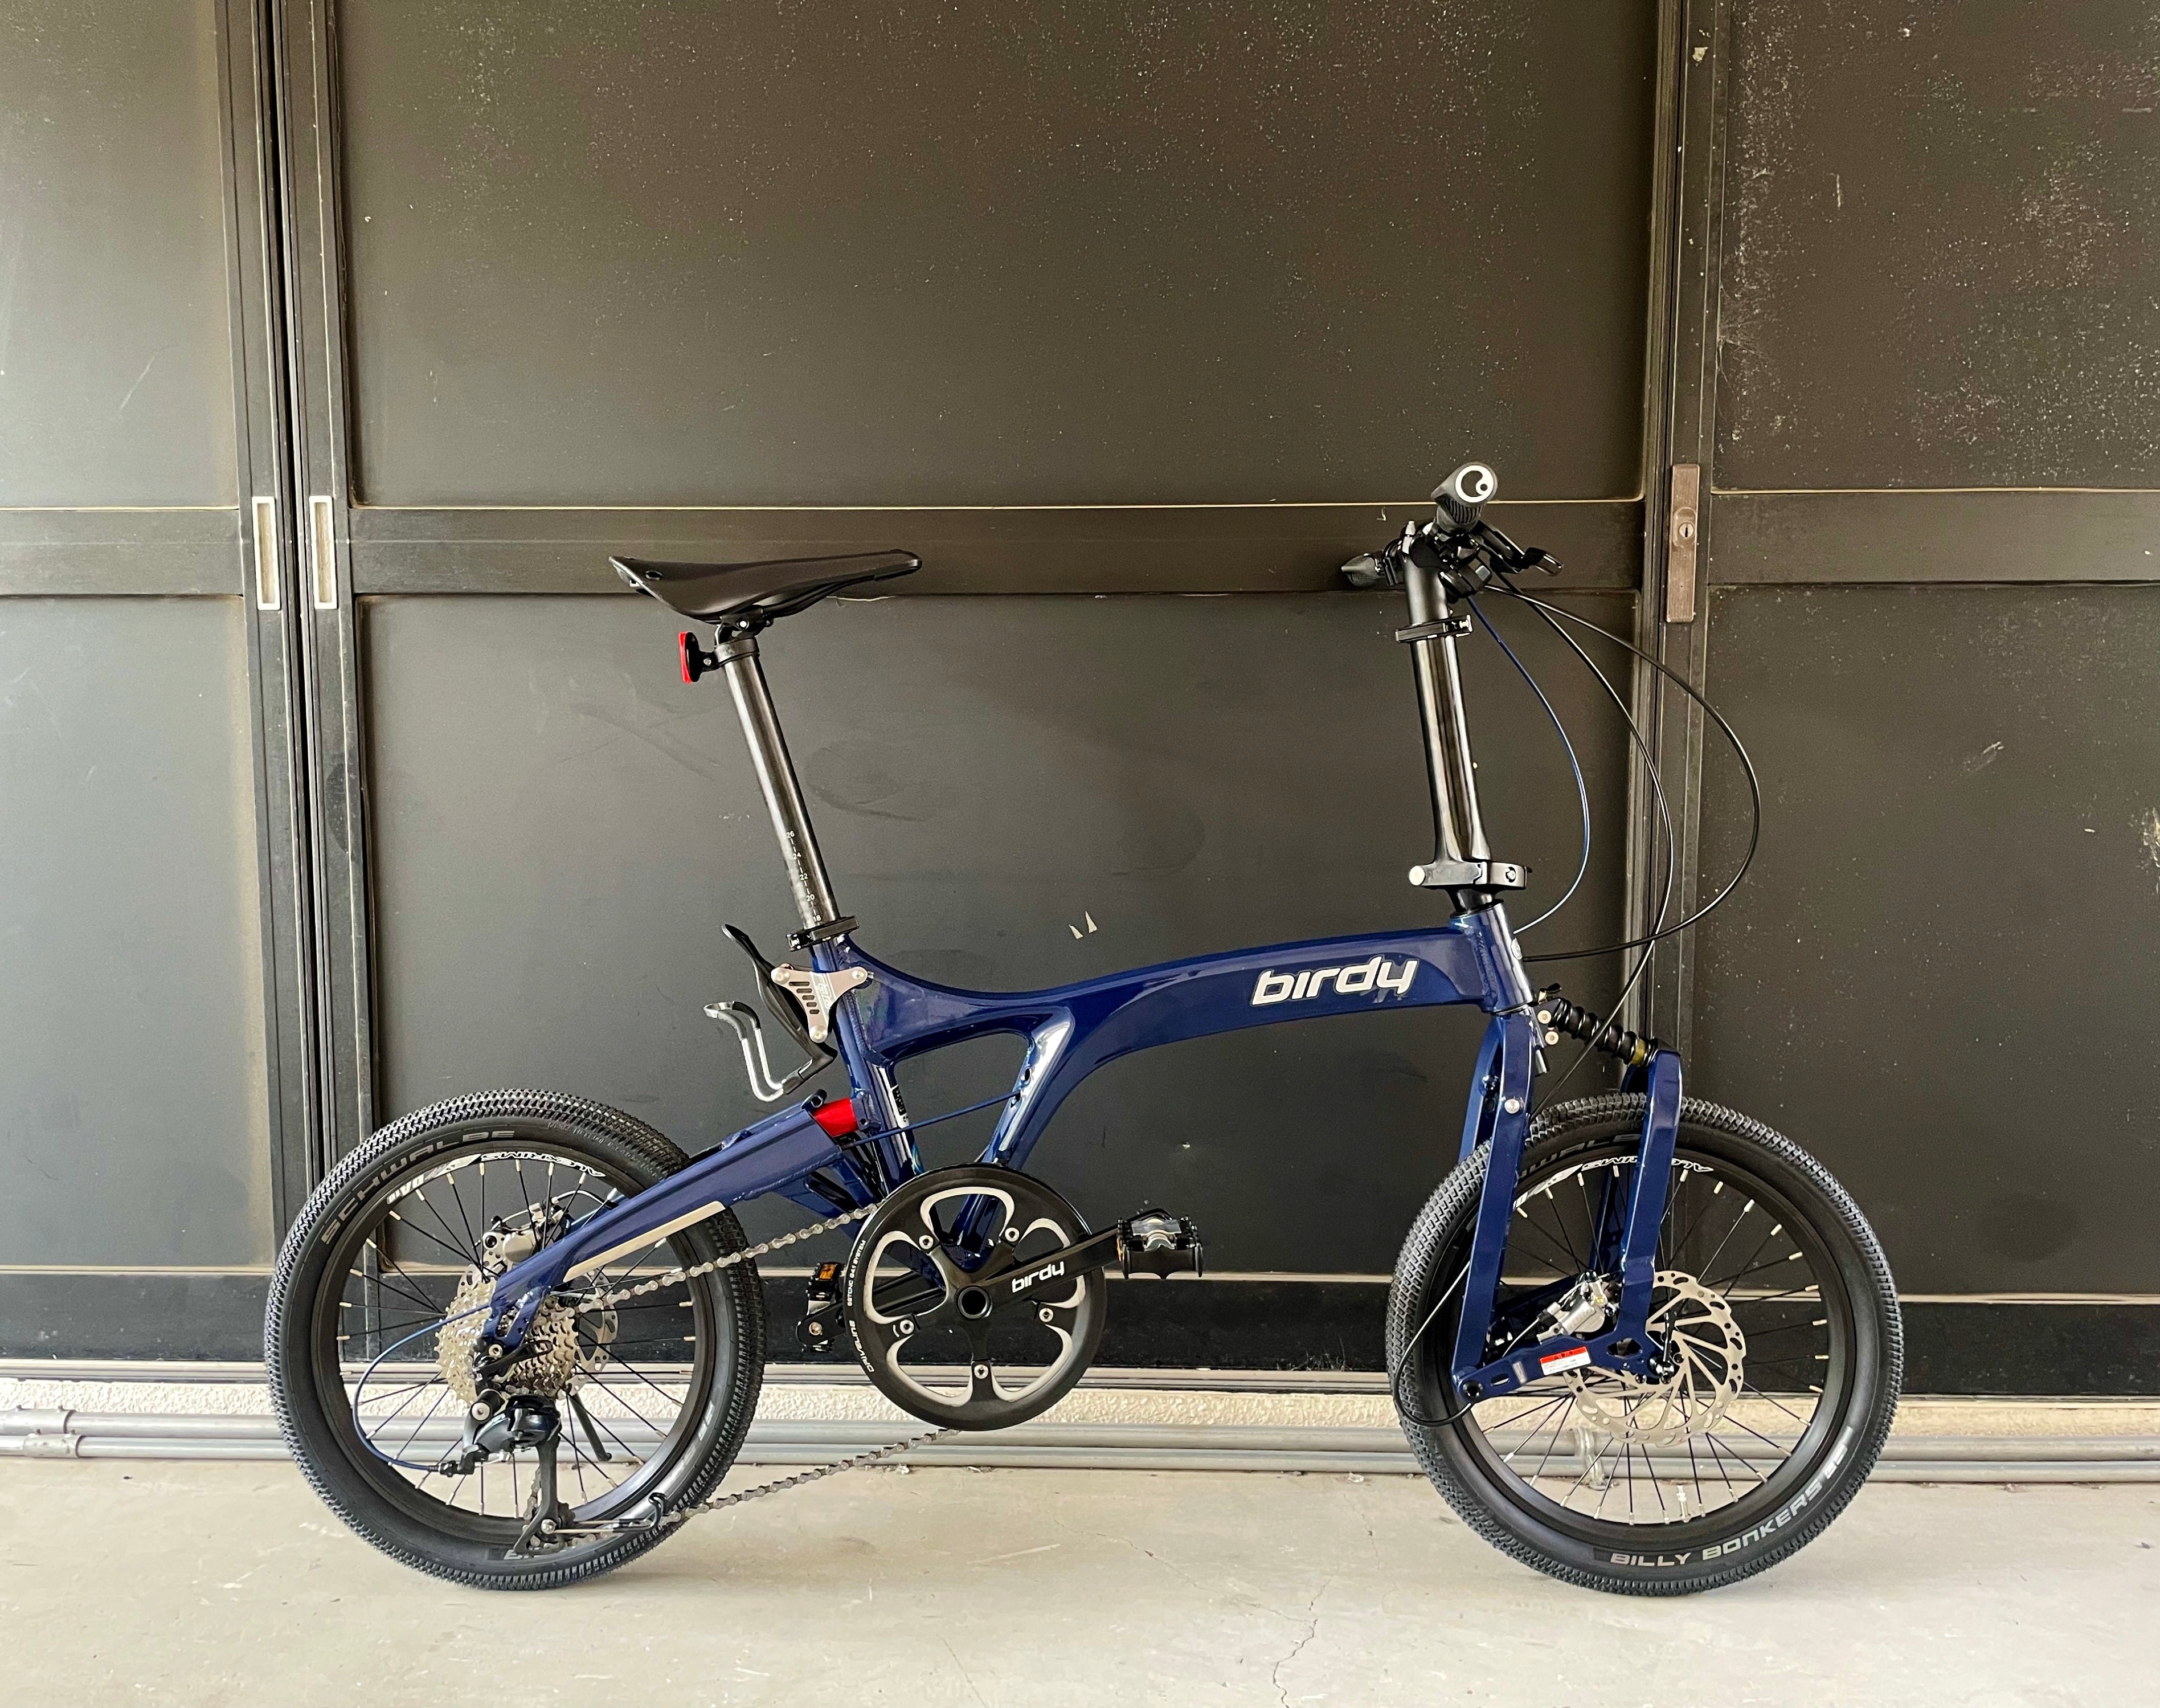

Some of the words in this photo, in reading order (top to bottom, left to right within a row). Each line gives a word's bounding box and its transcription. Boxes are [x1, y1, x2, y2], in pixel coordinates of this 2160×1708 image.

[1251, 955, 1419, 1006] birdy
[321, 1130, 515, 1244] SCHWALBE
[1011, 1261, 1065, 1293] birdy
[849, 1319, 875, 1373] DRIVELINE
[1610, 1552, 1692, 1567] BILLY
[1702, 1480, 1823, 1561] BONKERS
